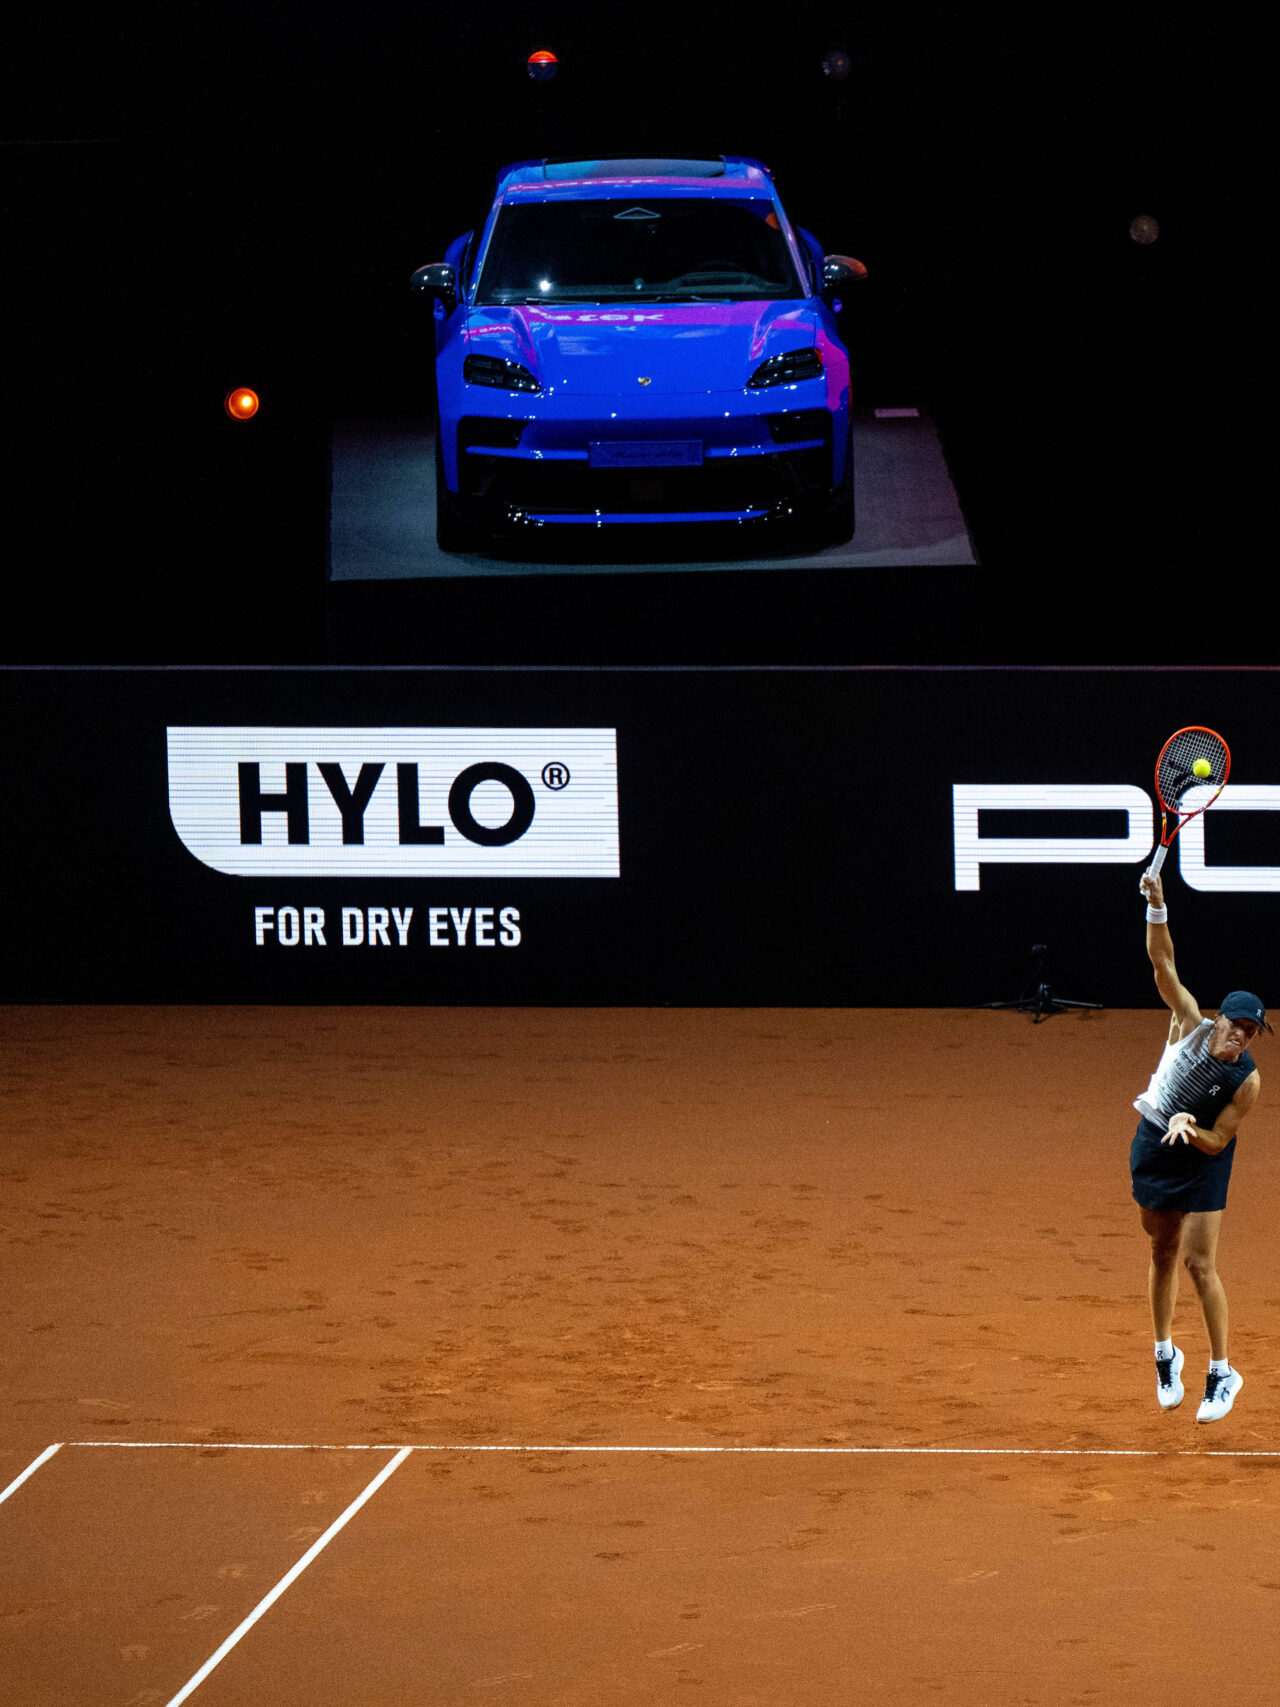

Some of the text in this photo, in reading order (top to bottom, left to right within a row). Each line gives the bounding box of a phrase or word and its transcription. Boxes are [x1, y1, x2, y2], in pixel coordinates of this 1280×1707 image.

[255, 906, 522, 947] FOR DRY EYES
